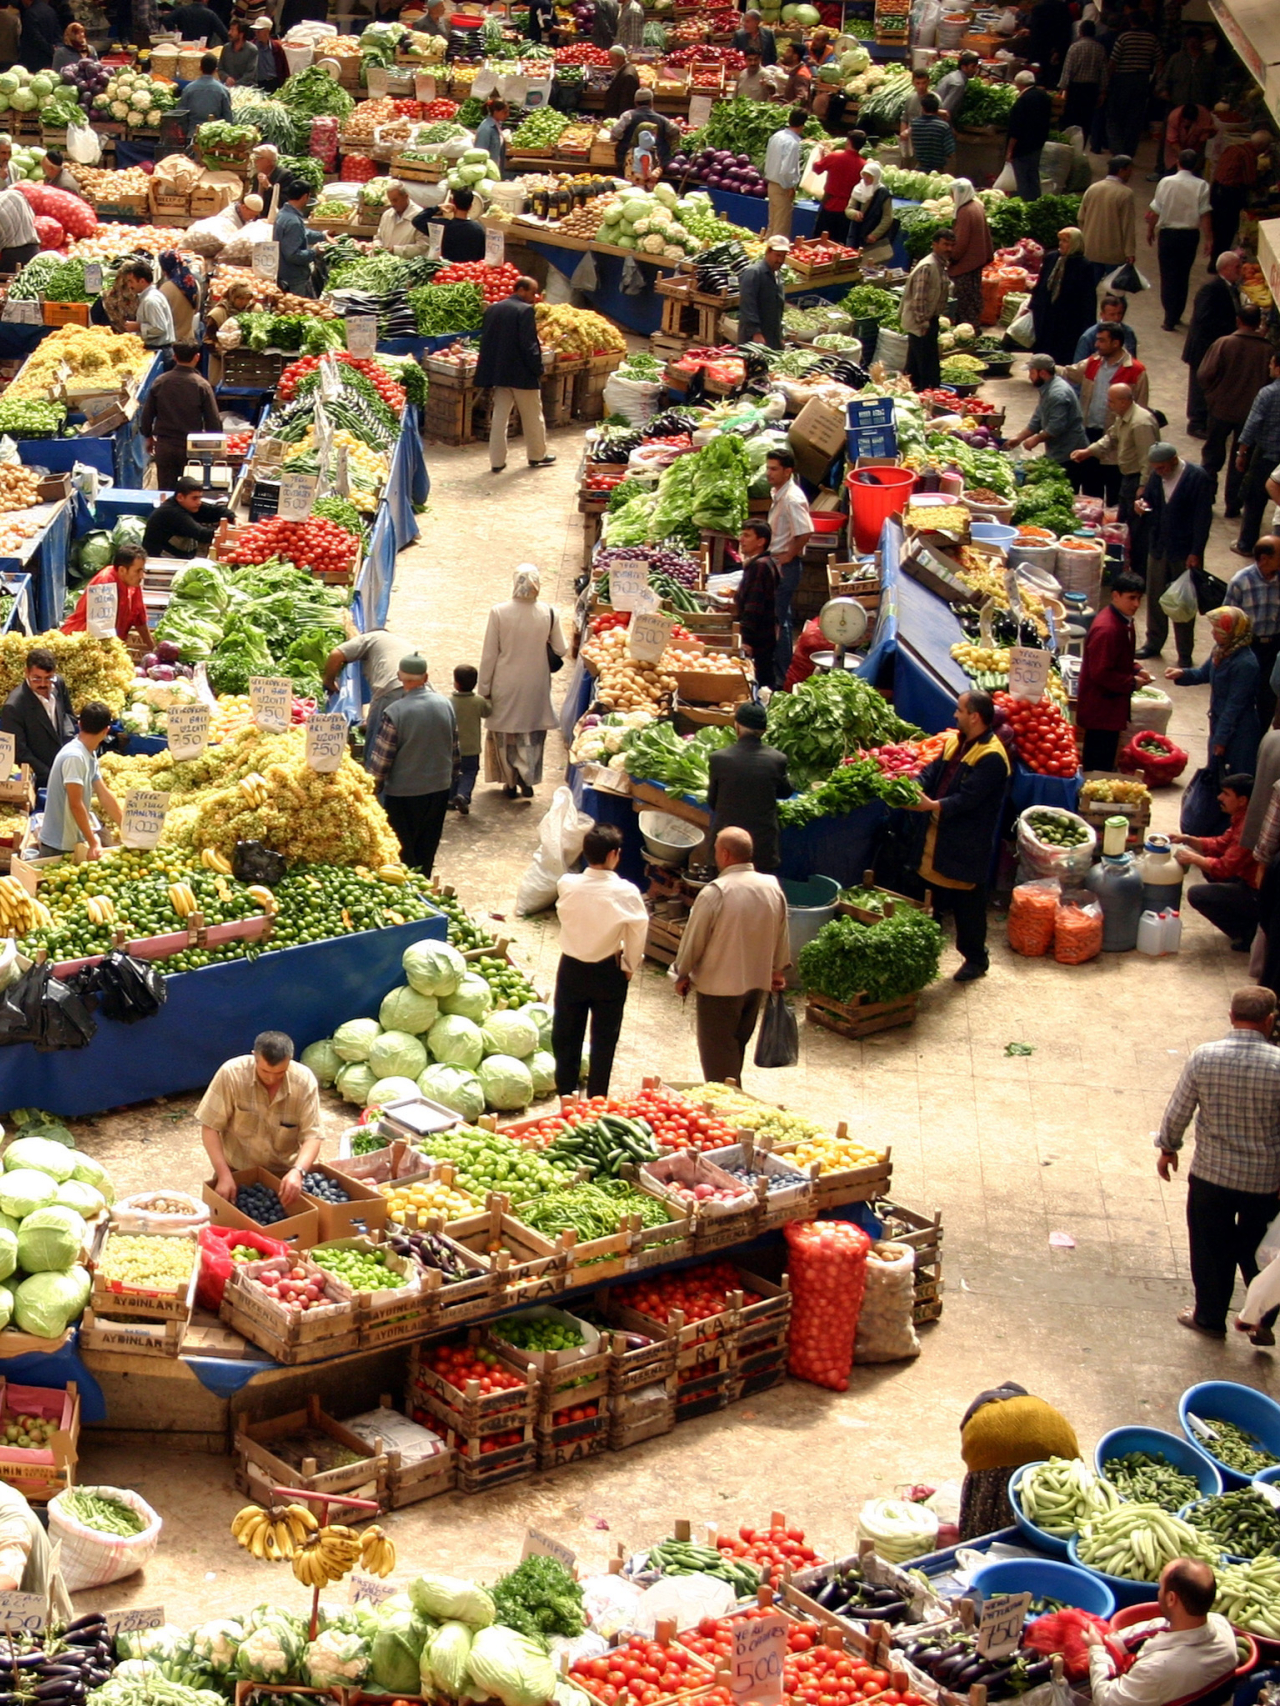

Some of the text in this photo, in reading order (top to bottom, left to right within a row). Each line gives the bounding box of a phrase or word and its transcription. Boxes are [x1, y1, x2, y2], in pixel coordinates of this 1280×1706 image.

[283, 498, 306, 509] 500
[612, 581, 640, 594] 500
[634, 627, 664, 645] 500
[1014, 668, 1041, 684] 500
[257, 704, 285, 720] 750
[172, 734, 202, 746] 750
[312, 743, 341, 756] 750
[111, 1618, 161, 1636] 1250
[981, 1615, 1019, 1649] 750
[731, 1650, 782, 1694] 500
